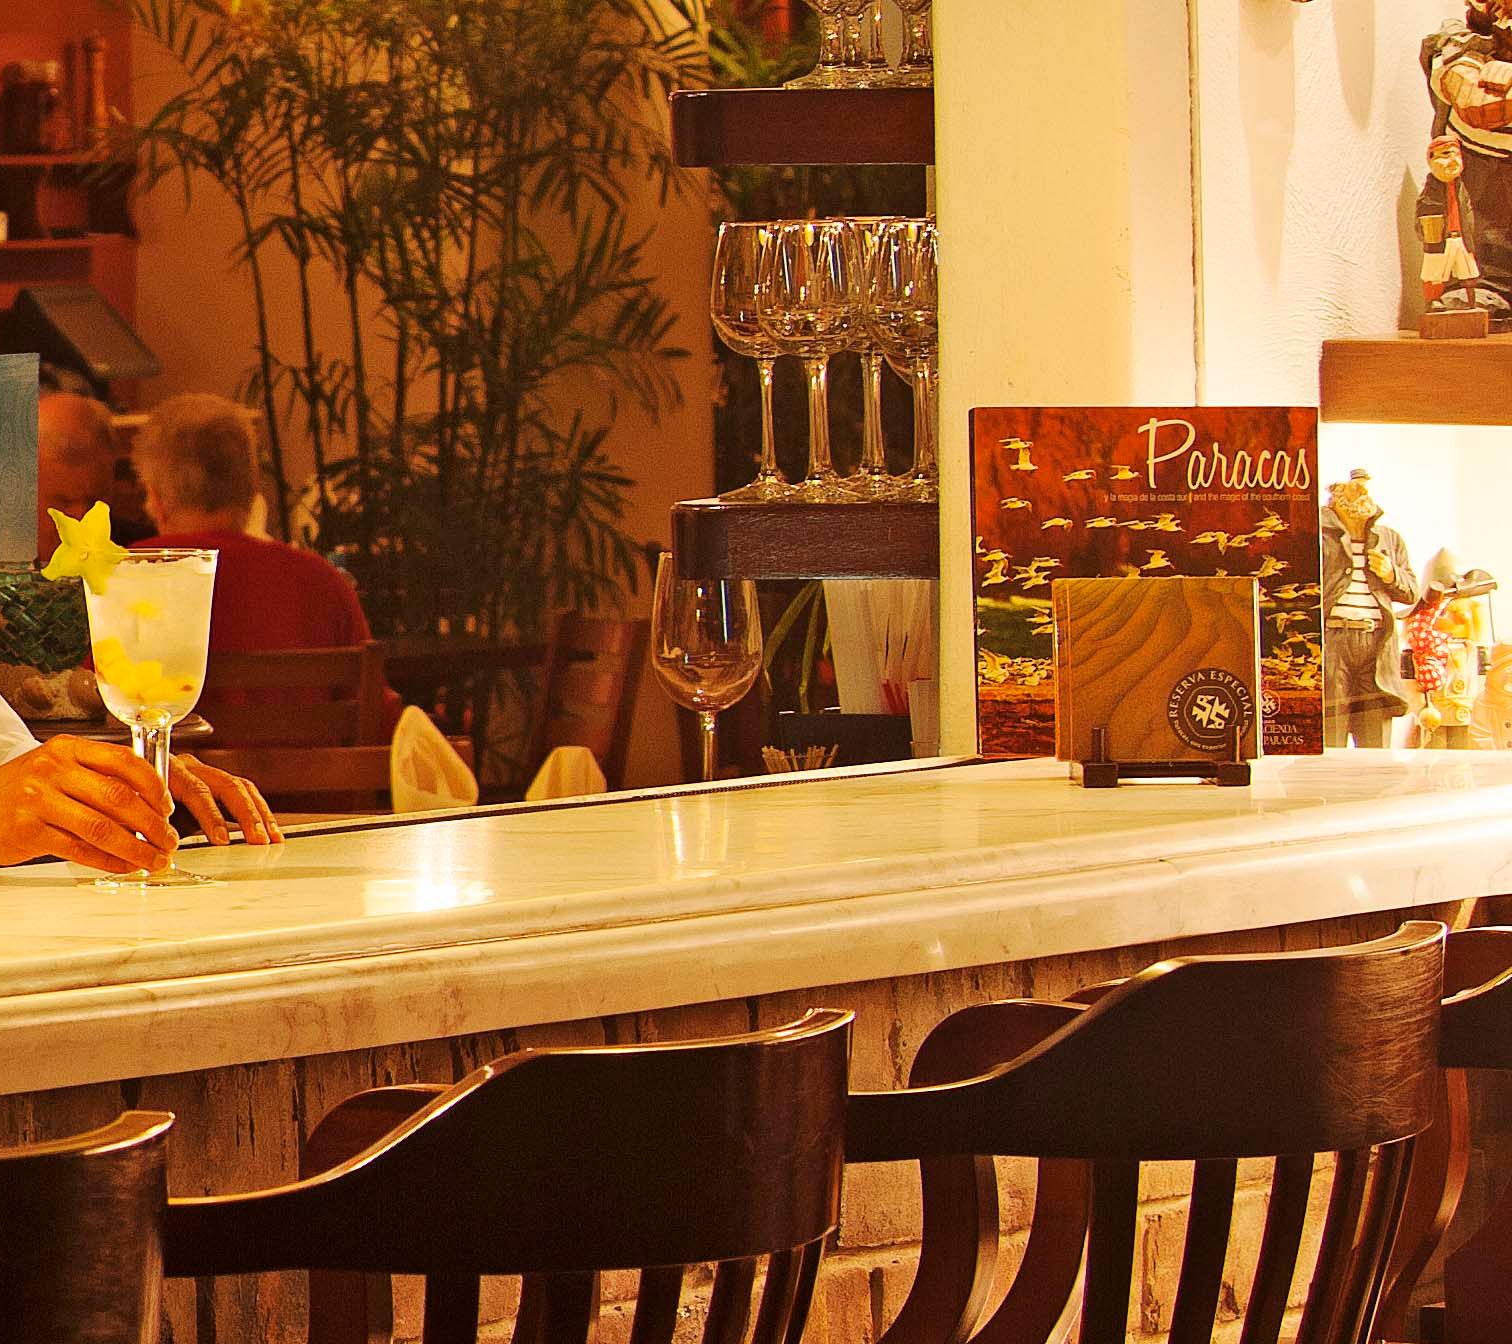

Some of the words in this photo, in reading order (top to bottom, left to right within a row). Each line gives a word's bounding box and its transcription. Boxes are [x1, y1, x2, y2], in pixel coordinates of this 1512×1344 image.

[1137, 417, 1310, 490] Paracas
[1169, 672, 1206, 718] RESERVA
[1210, 670, 1253, 718] ESPECIAL
